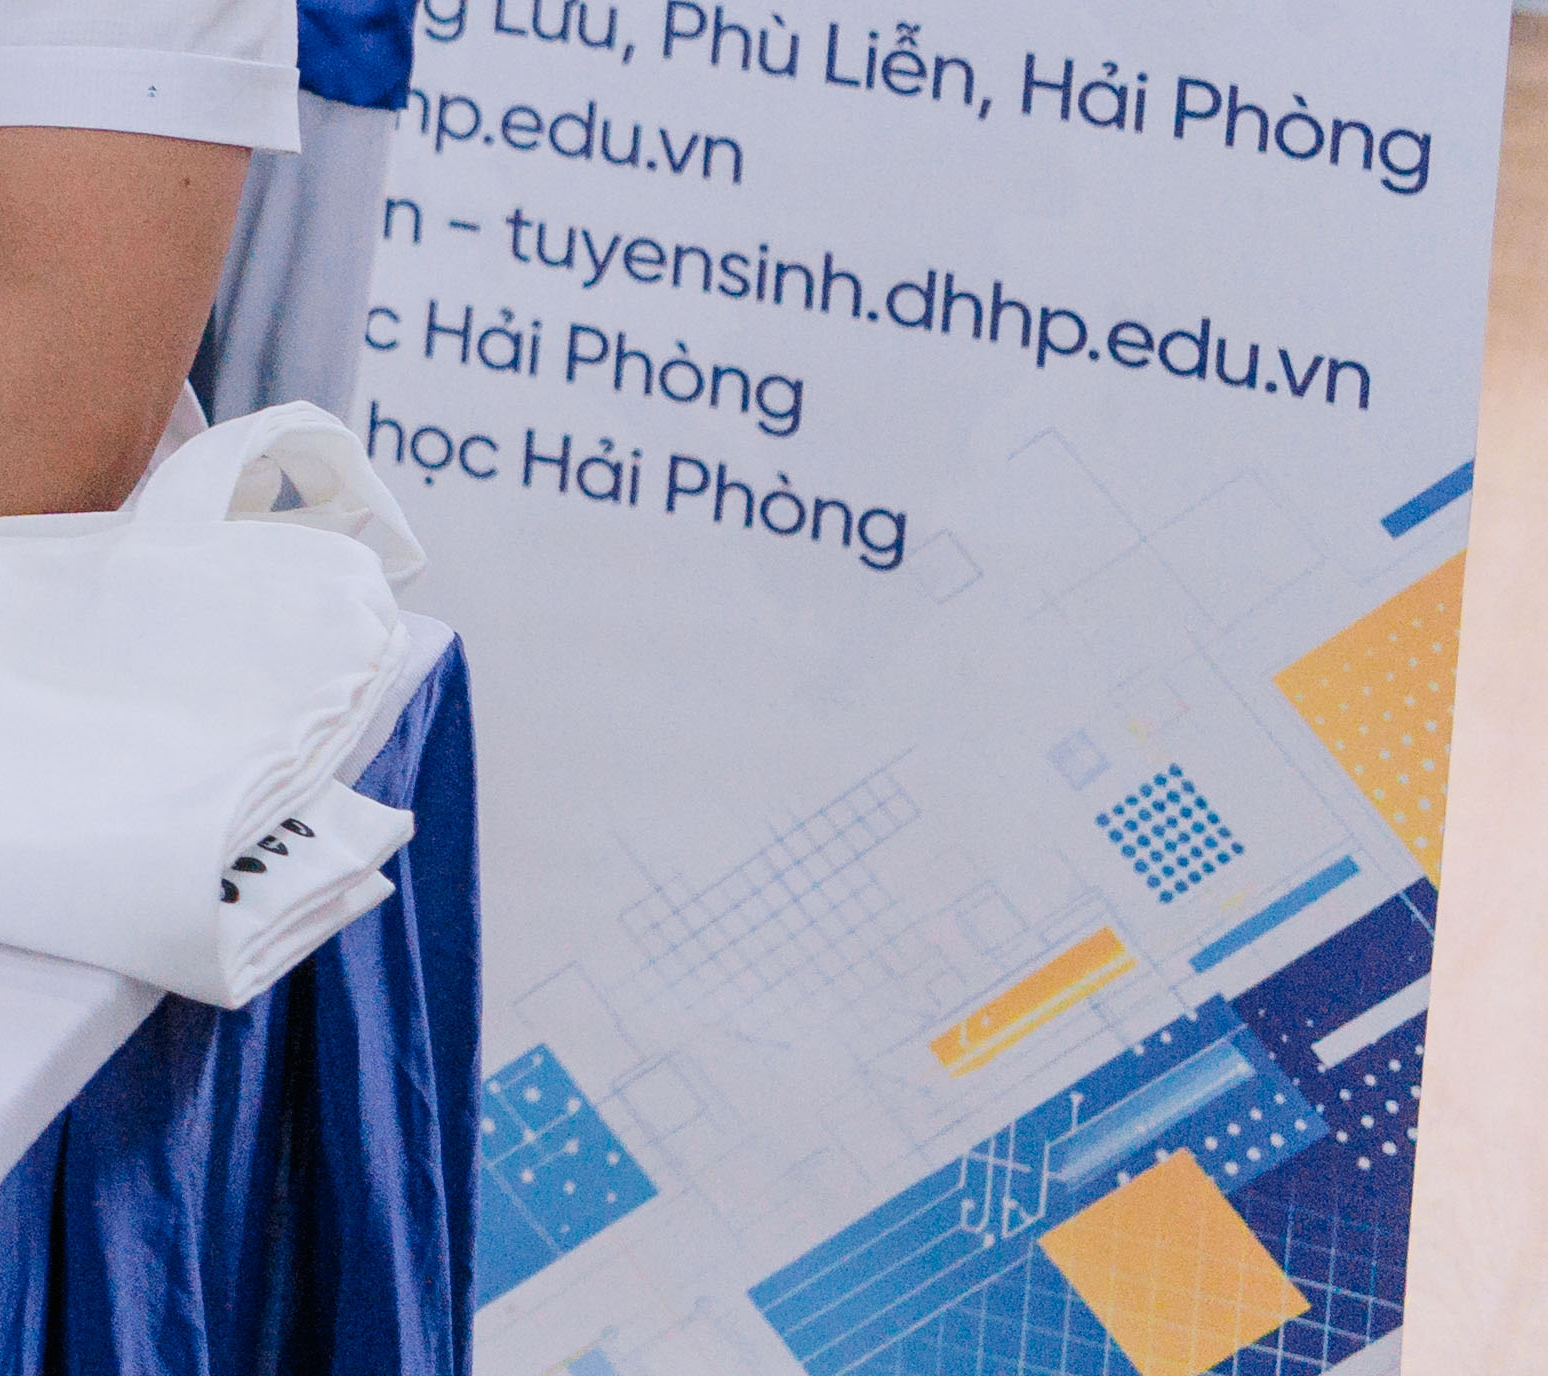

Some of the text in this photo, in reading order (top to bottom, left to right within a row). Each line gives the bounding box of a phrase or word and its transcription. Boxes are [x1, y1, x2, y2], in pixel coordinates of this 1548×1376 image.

[825, 21, 993, 122] Liễn,
[1021, 54, 1146, 135] Hải
[1172, 77, 1435, 195] Phòng
[424, 299, 541, 376] Hải
[565, 322, 805, 438] Phòng
[506, 205, 1372, 409] tuyensinh.dhhp.edu.vn
[367, 400, 910, 572] học Hải Phòng
